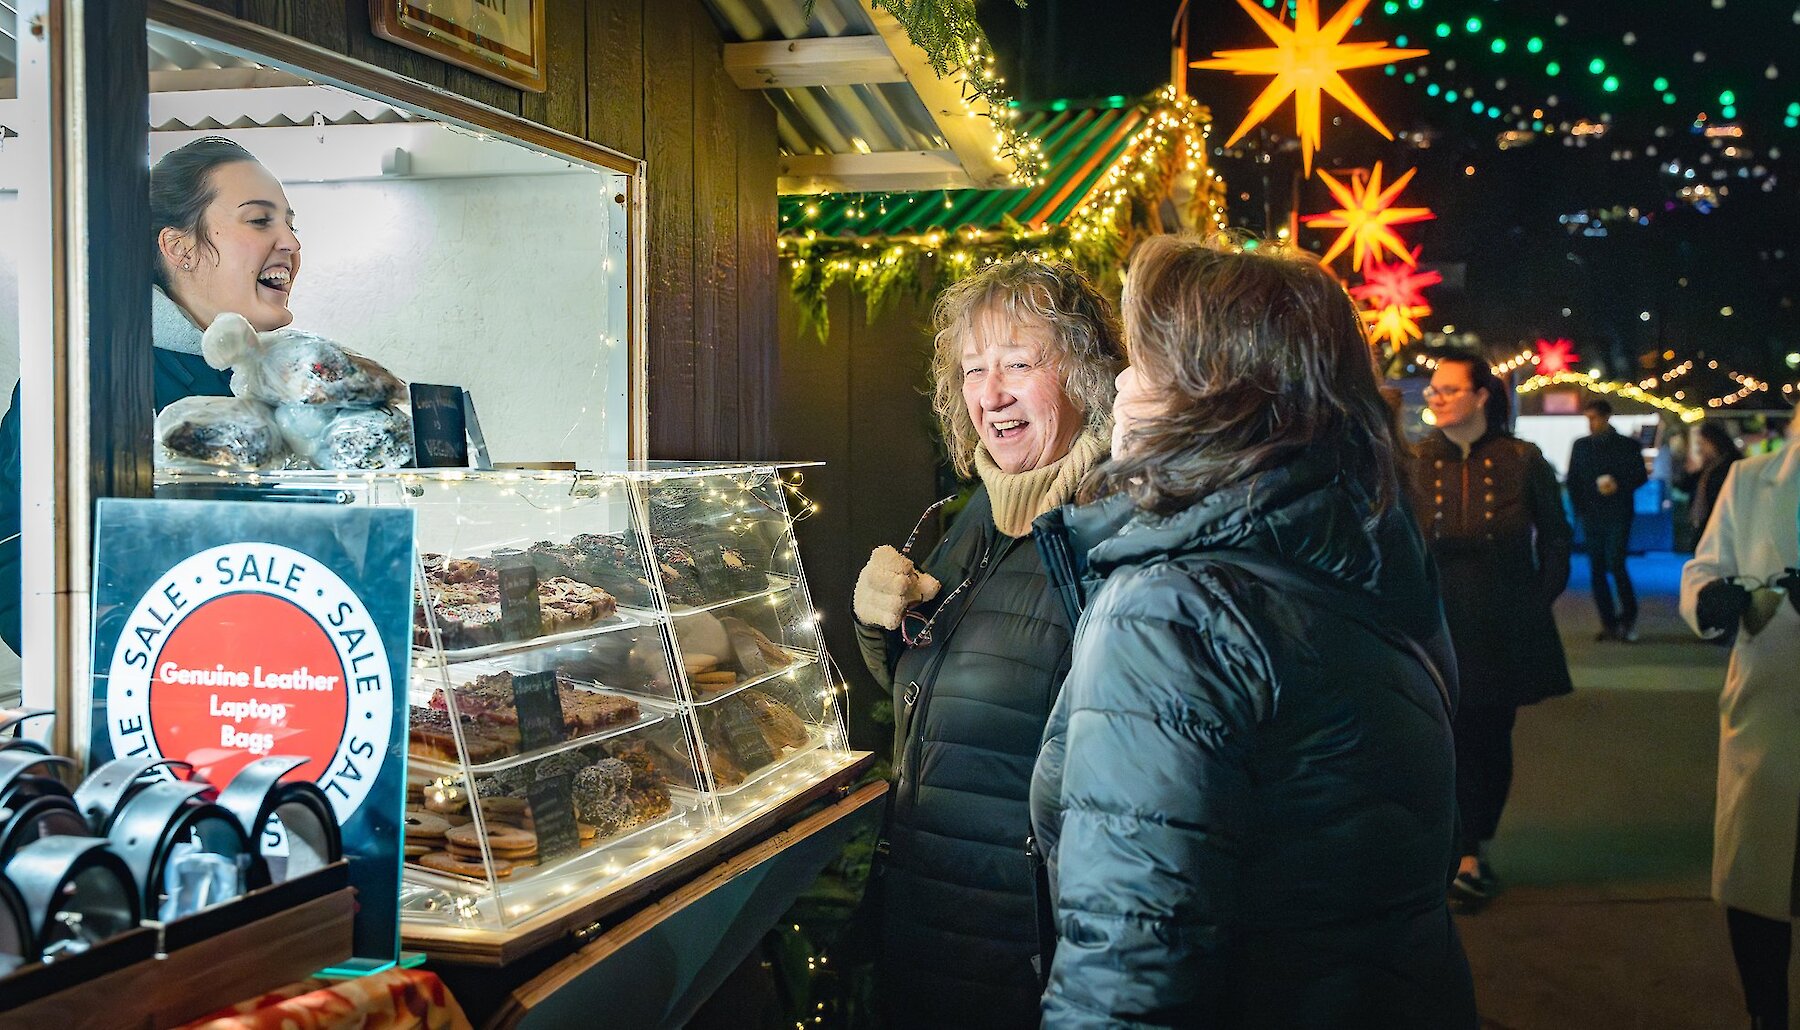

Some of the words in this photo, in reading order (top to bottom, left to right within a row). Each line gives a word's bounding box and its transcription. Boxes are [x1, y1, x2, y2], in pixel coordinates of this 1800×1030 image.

[216, 554, 306, 594] SALE
[124, 582, 188, 670] SALE
[327, 601, 381, 695] SALE
[159, 661, 251, 690] Genuine
[253, 666, 340, 693] Leather
[209, 694, 287, 725] Laptop
[220, 725, 274, 757] Bags
[324, 736, 374, 799] SAL
